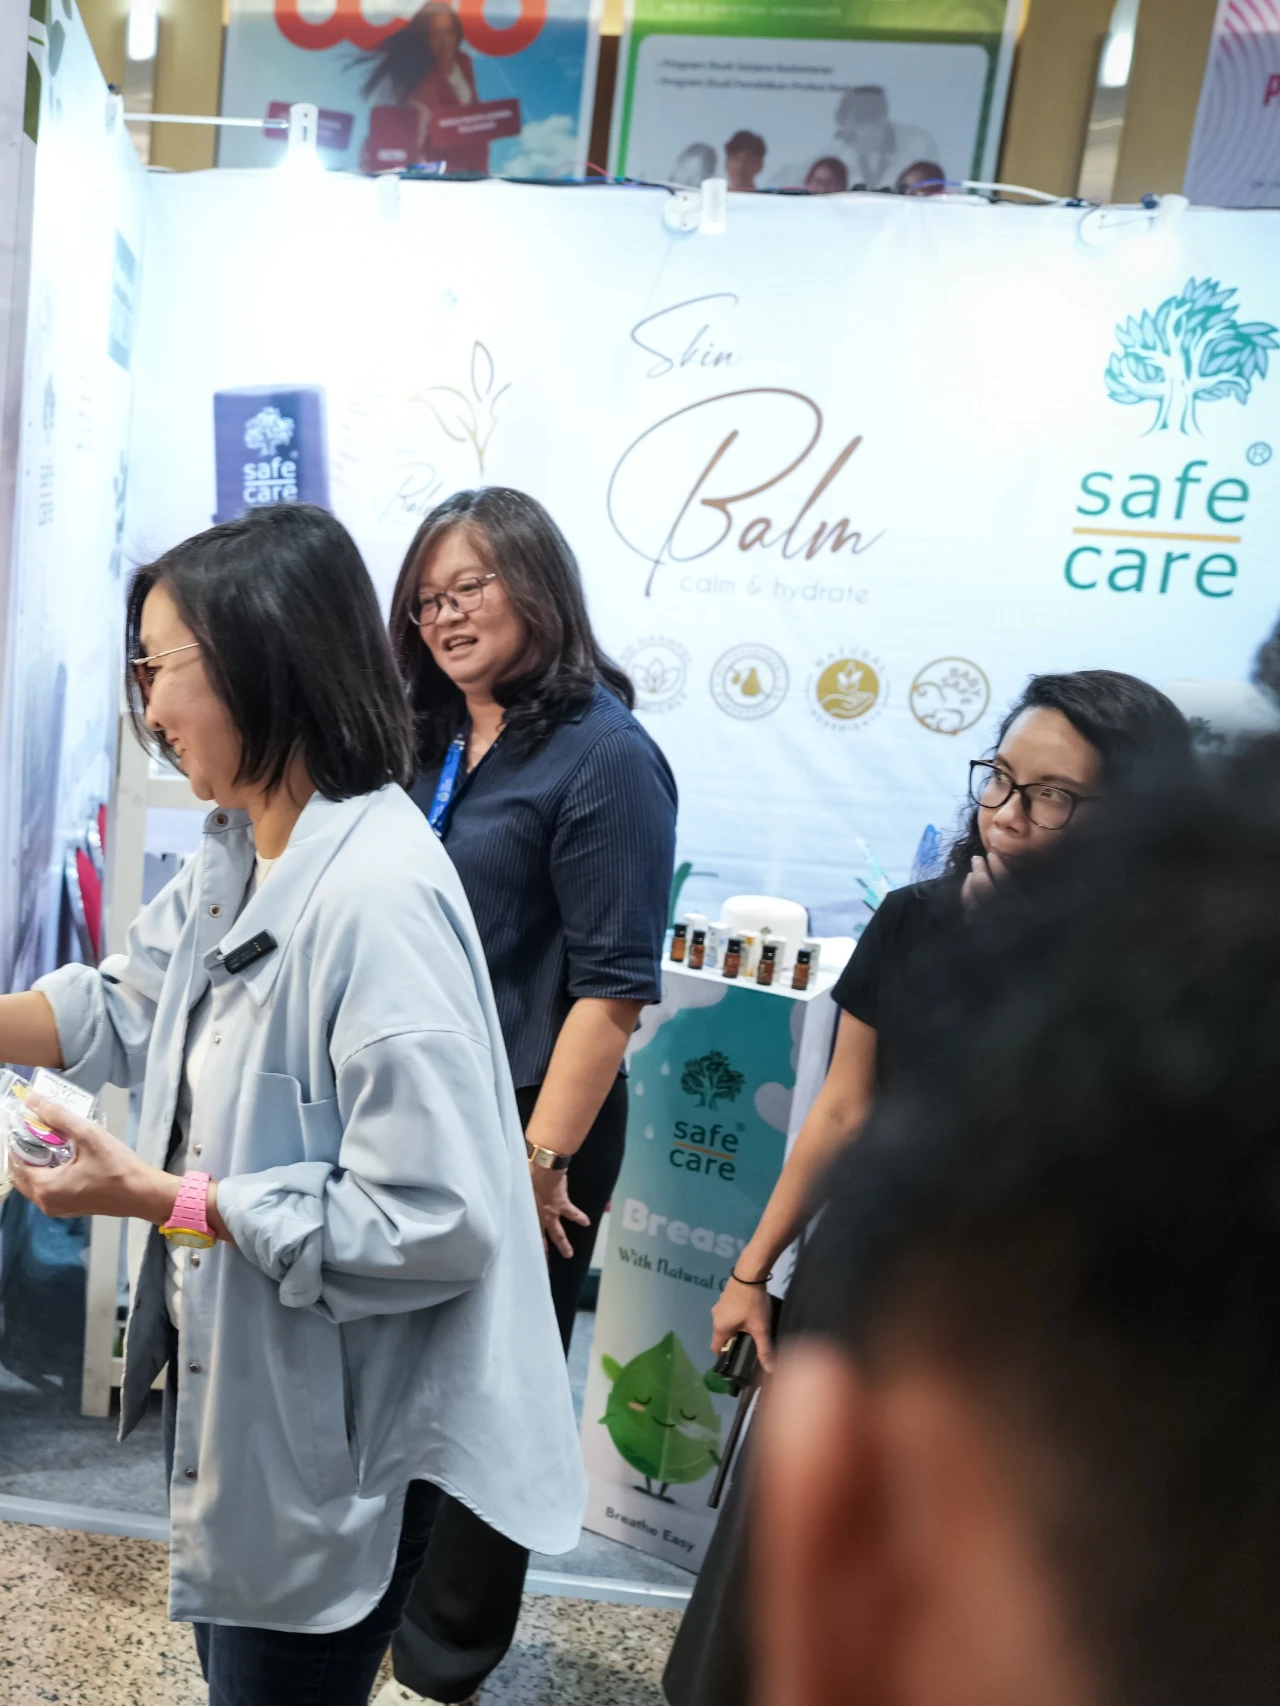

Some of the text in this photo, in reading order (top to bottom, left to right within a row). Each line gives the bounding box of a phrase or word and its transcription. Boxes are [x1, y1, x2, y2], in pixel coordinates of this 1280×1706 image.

[630, 292, 739, 379] Skin
[243, 456, 297, 480] safe
[243, 485, 298, 503] care
[606, 387, 888, 598] Balm
[1076, 459, 1250, 524] safe
[680, 575, 870, 604] calm & hydrate
[1063, 546, 1238, 599] care
[673, 1120, 739, 1153] safe
[669, 1148, 736, 1181] care
[621, 1198, 745, 1258] Breas
[617, 1246, 652, 1271] With
[657, 1258, 715, 1290] Natural
[605, 1506, 696, 1553] Breathe Easy
